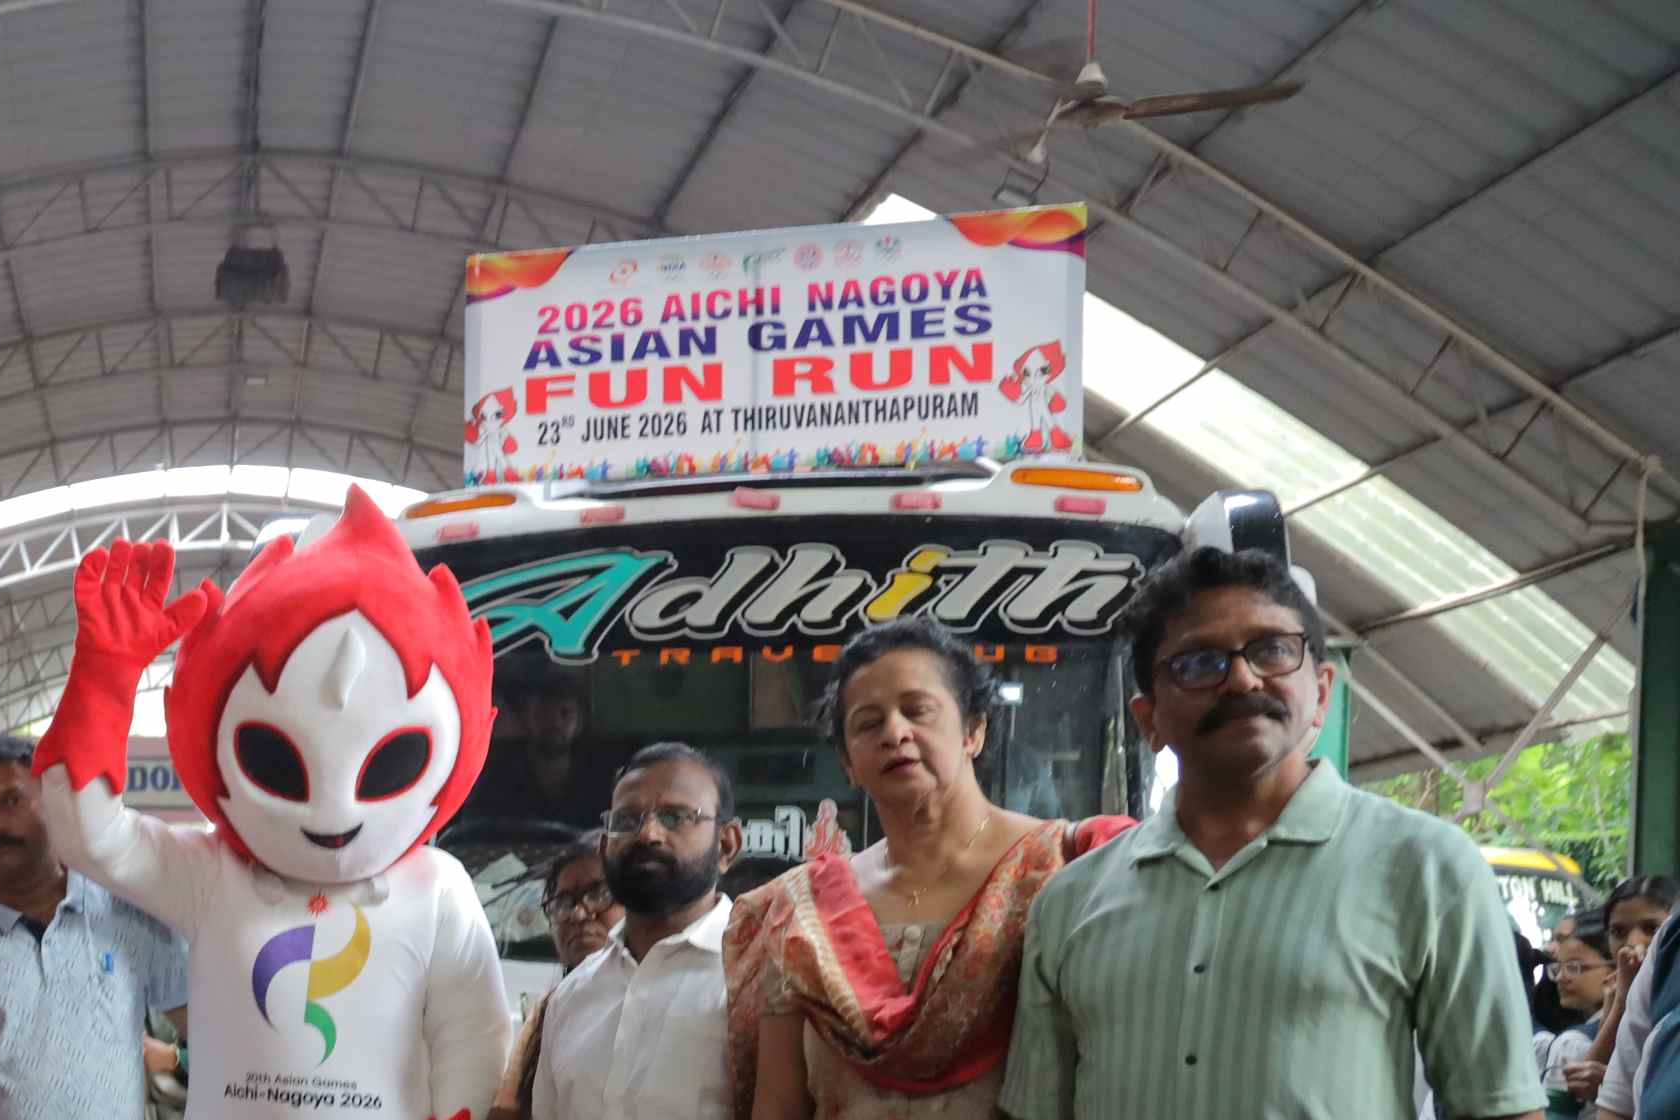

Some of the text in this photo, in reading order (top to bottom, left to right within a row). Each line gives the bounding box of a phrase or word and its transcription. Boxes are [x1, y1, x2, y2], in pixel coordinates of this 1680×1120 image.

[537, 266, 988, 335] 2026 AICHI NAGOYA
[523, 303, 993, 370] ASIAN GAMES
[525, 341, 994, 416] FUN RUN
[581, 415, 631, 443] JUNE
[638, 411, 688, 438] 2026
[700, 408, 725, 434] AT
[731, 391, 979, 433] THIRUVANANTHAPURAM
[613, 643, 1058, 664] TRAVE UB
[224, 1083, 383, 1110] Aichi-Nagoya 2026
[275, 1073, 308, 1087] Asian
[312, 1076, 358, 1090] Games
